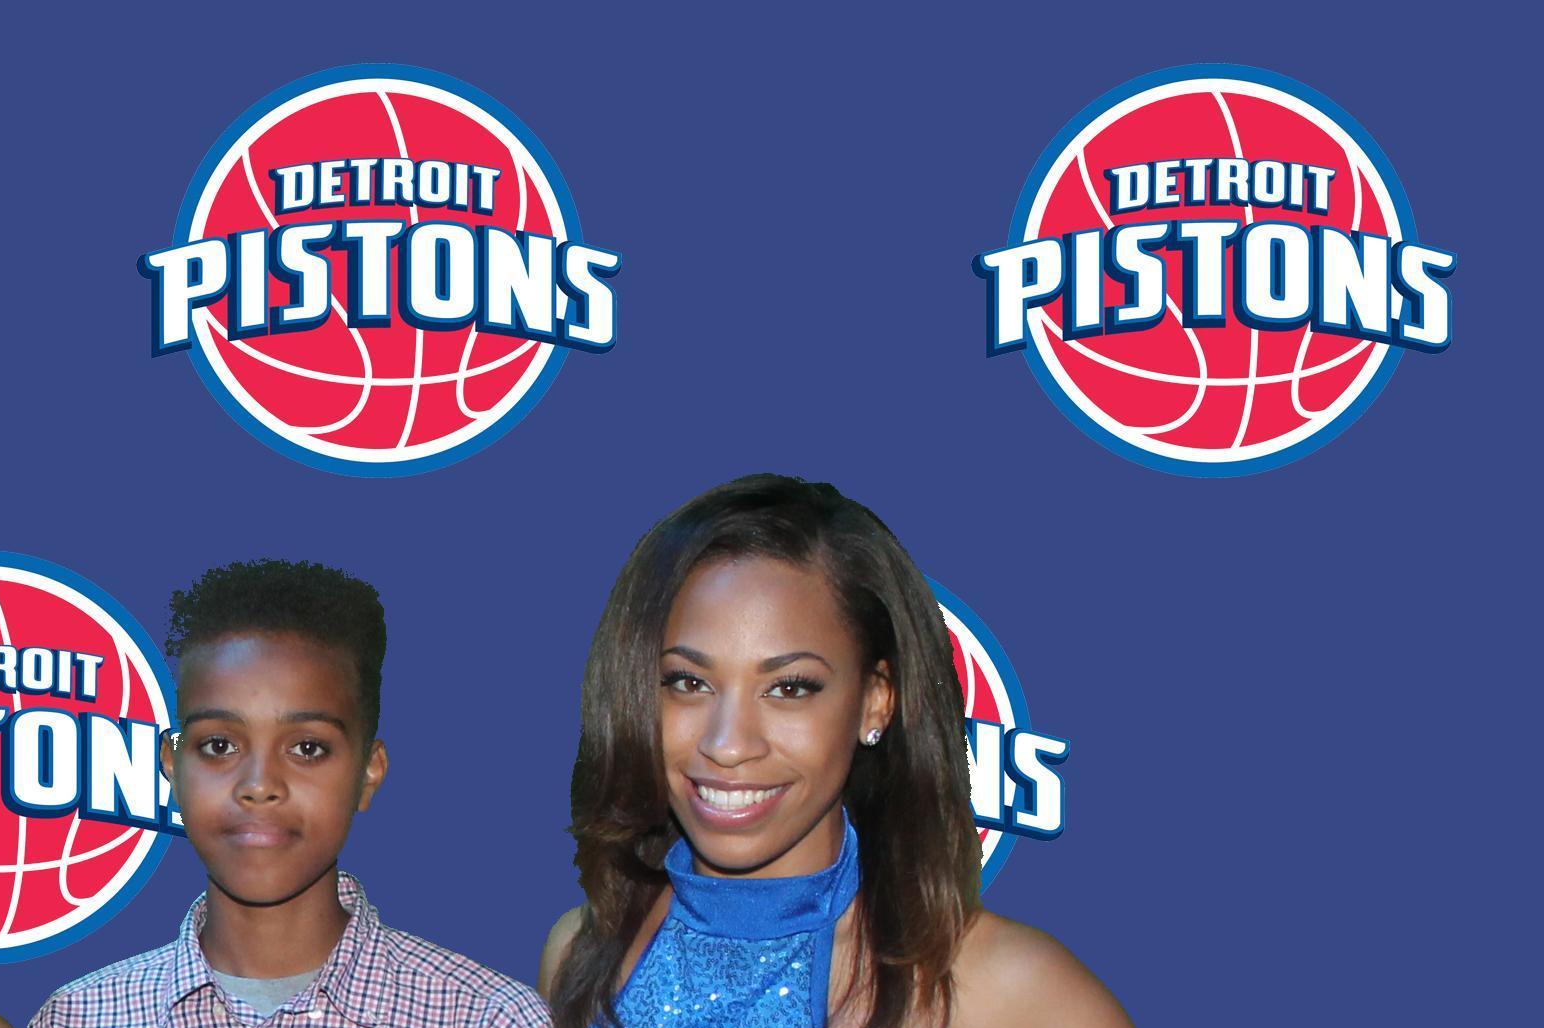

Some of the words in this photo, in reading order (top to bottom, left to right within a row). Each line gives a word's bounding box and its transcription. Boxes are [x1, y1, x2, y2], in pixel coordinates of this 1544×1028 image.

[271, 158, 501, 213] DETROIT
[1106, 158, 1336, 213] DETROIT
[138, 219, 621, 355] PISTONS
[973, 219, 1456, 355] PISTONS
